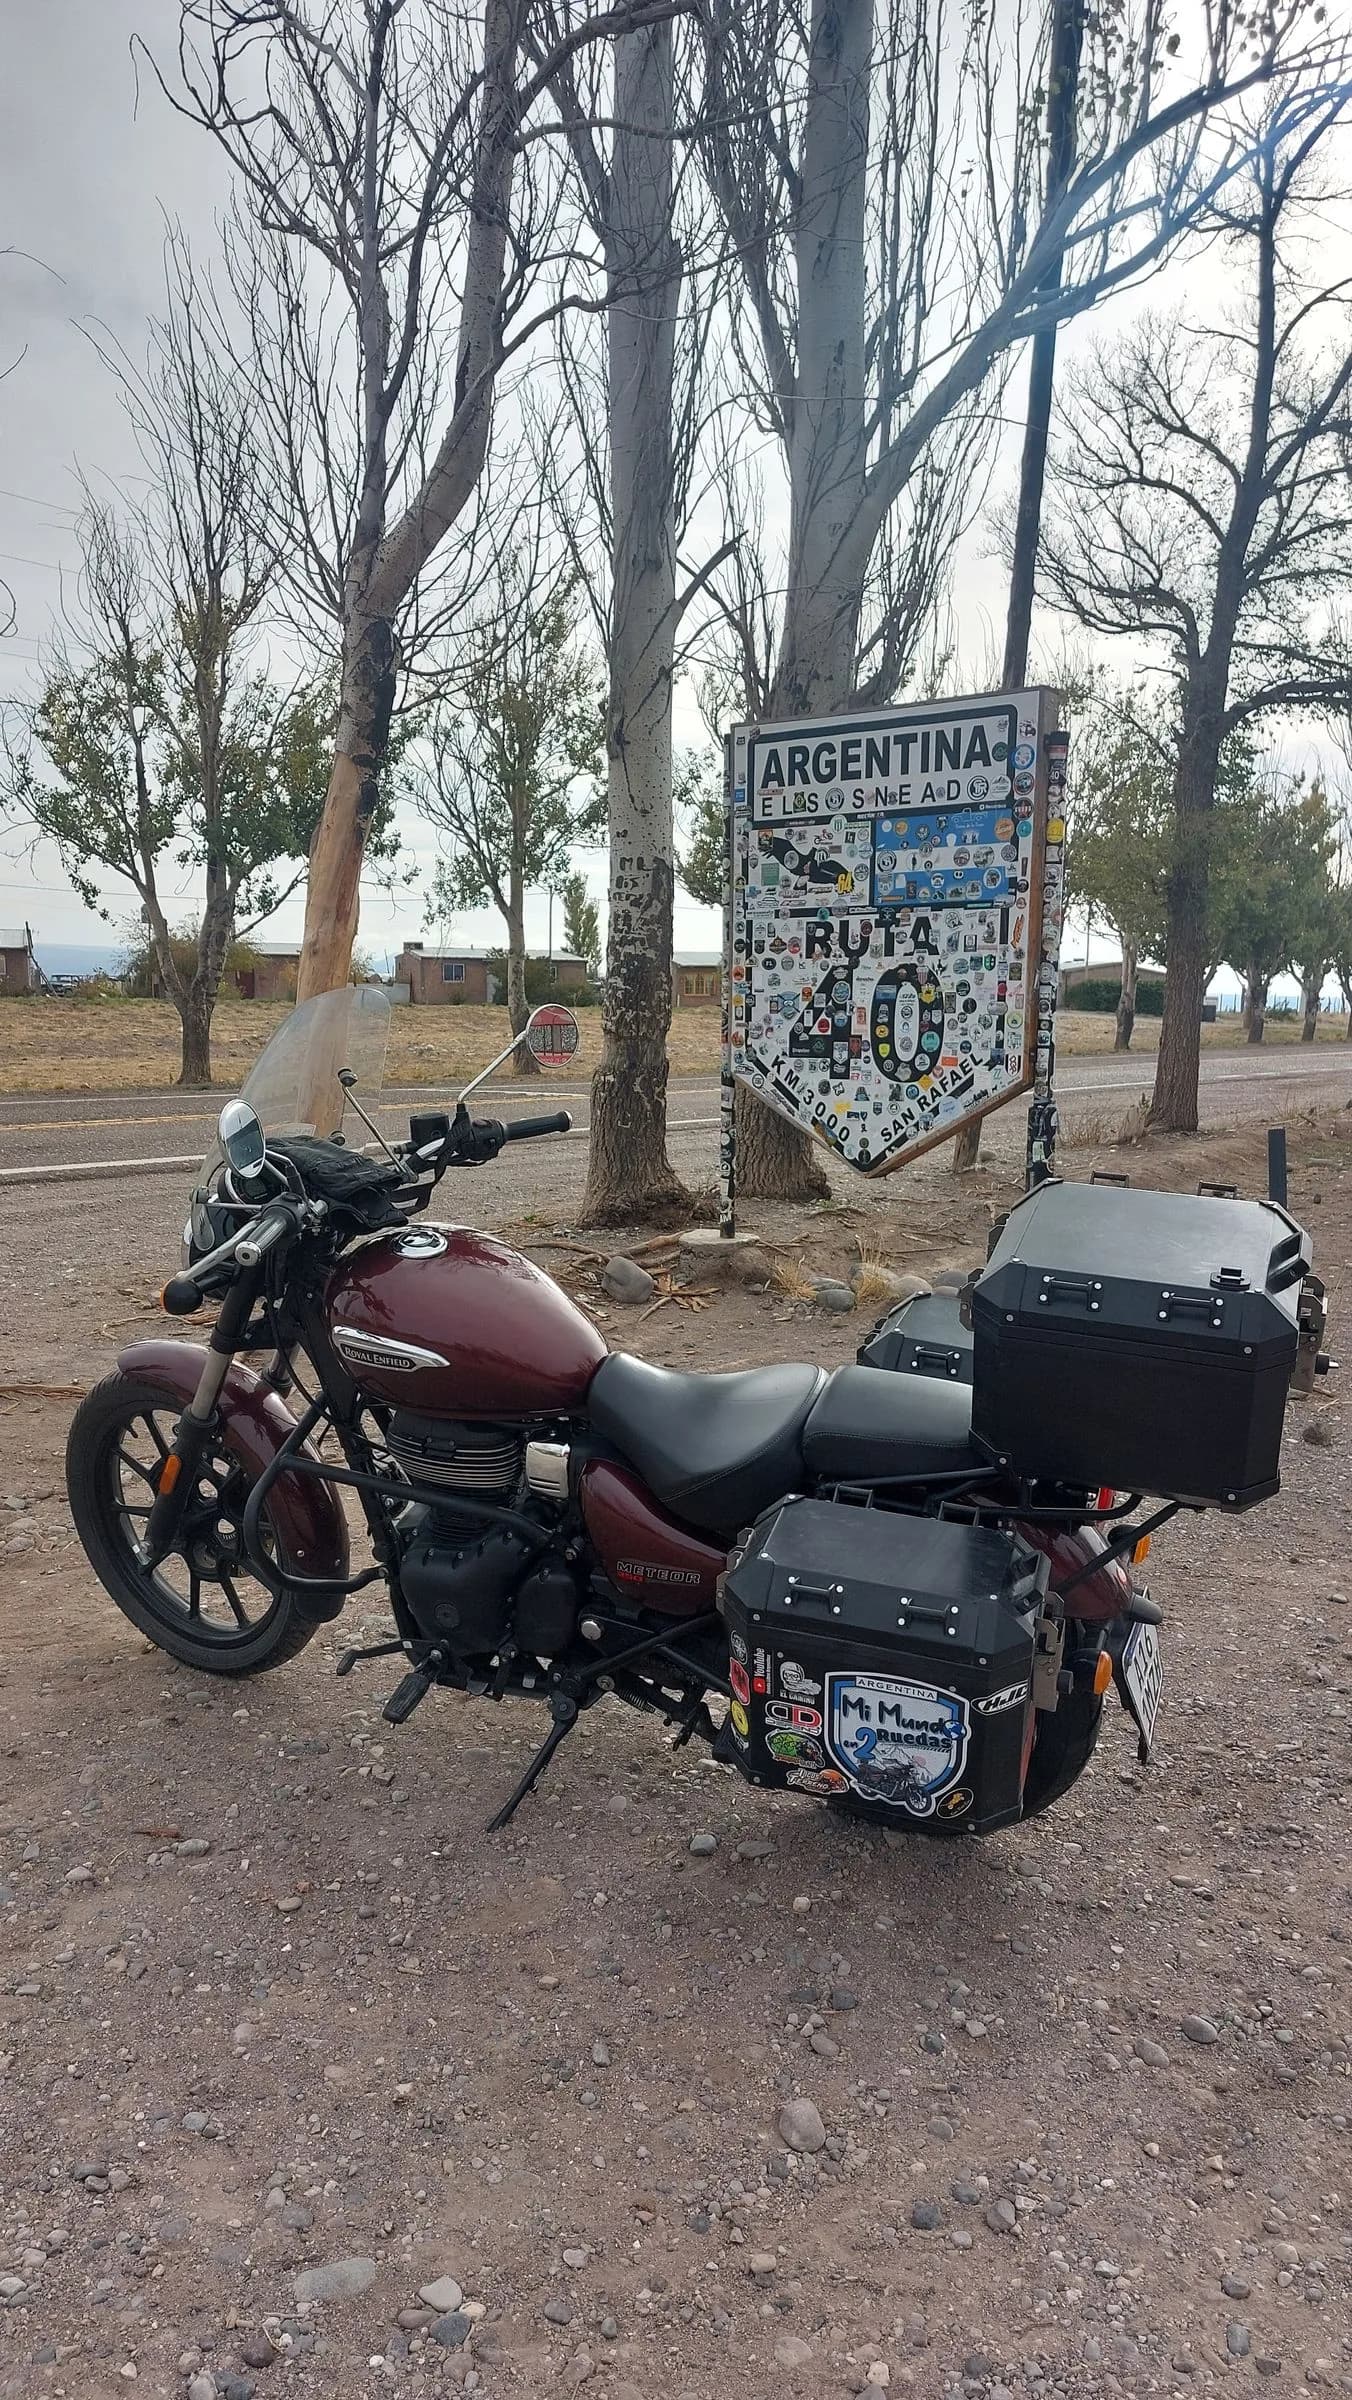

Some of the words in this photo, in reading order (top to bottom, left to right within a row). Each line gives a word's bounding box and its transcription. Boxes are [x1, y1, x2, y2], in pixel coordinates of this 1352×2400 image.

[761, 725, 992, 789] ARGENTINA
[762, 795, 793, 817] EL
[805, 916, 940, 959] RUTA
[788, 963, 945, 1083] 40
[771, 1054, 800, 1090] KM
[803, 1089, 850, 1142] 3000
[881, 1107, 915, 1143] SAN
[917, 1054, 983, 1112] RAFAEL
[345, 1347, 372, 1363] ROYAL
[373, 1354, 411, 1368] ENFIELD
[617, 1561, 700, 1584] METEOR
[754, 1647, 765, 1677] YouTube
[857, 1678, 936, 1699] ARGENTINA
[983, 1683, 1029, 1710] HJC
[842, 1694, 872, 1722] Mi
[843, 1740, 858, 1749] en
[853, 1727, 877, 1760] 2
[876, 1728, 952, 1749] Ruedas
